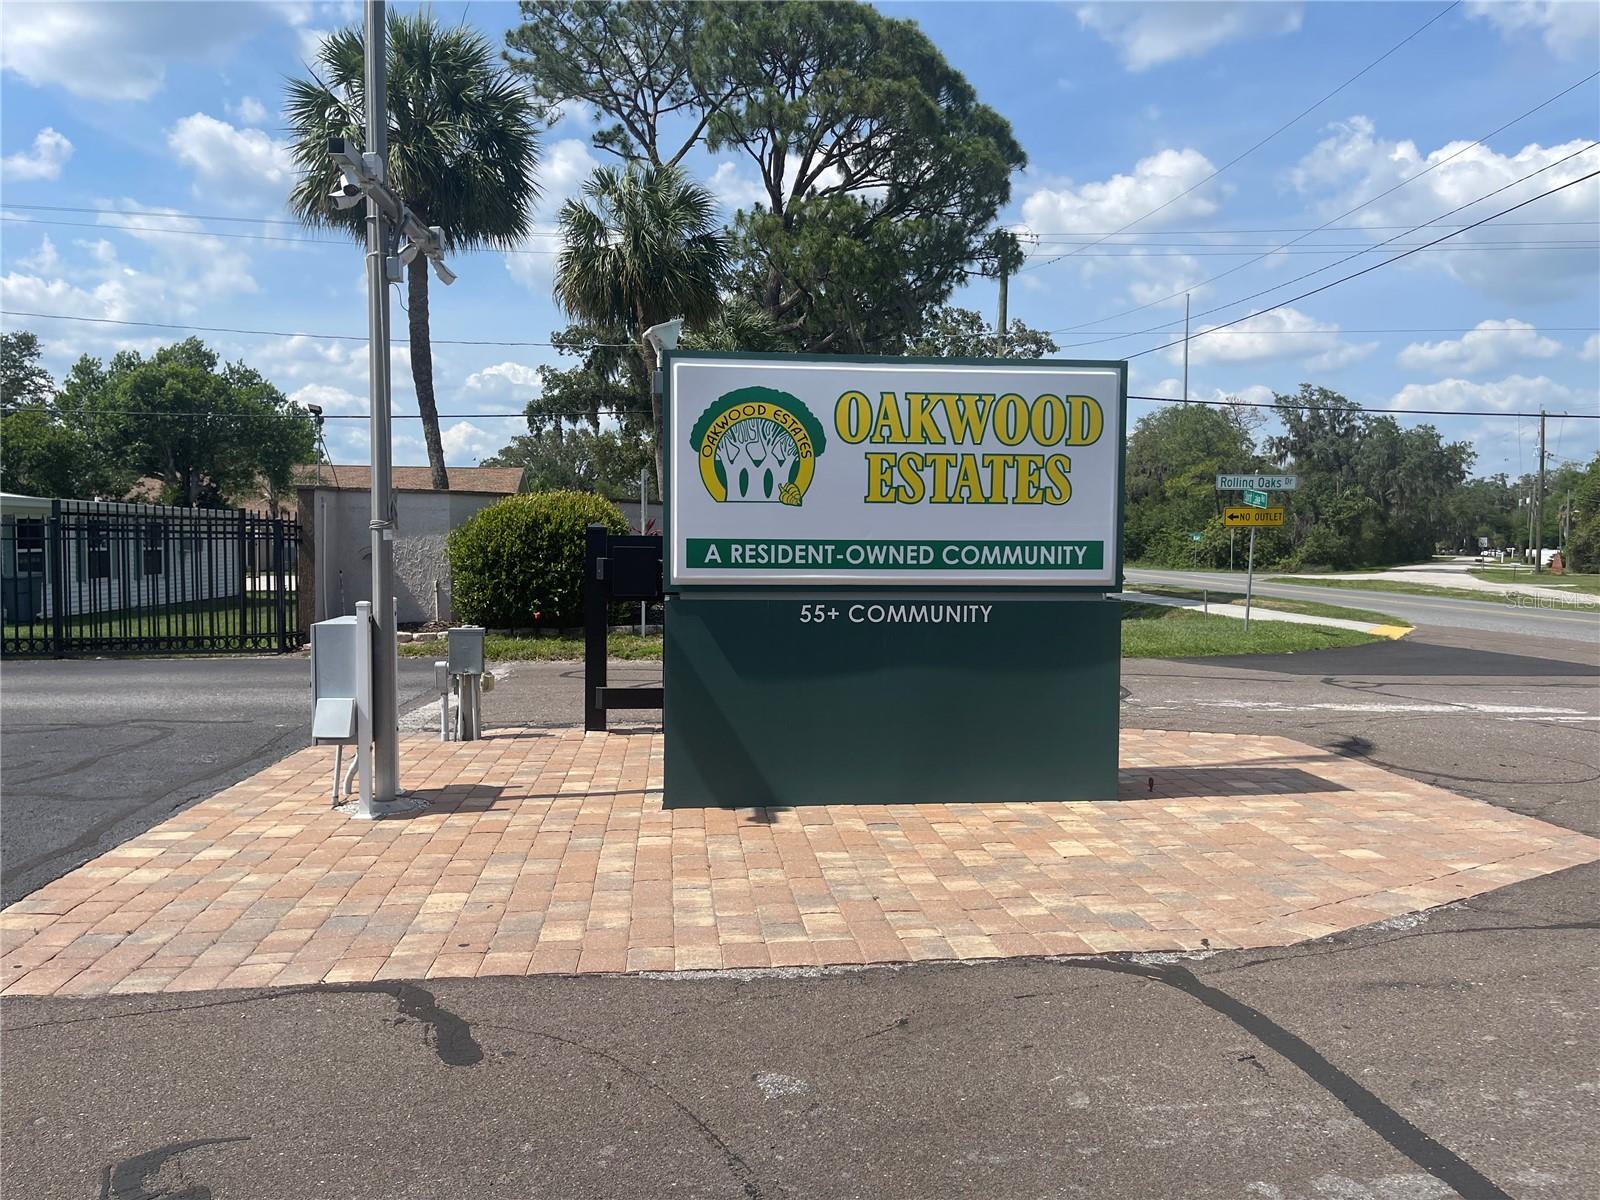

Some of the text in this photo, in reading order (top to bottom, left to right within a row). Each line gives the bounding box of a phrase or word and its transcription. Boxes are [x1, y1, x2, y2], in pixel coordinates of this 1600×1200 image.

[834, 390, 1104, 446] OAKWOOD
[702, 404, 812, 459] OAKWOOD ESTATES
[864, 452, 1072, 506] ESTATES
[1220, 476, 1293, 489] Rolling Oaks Dr
[1240, 513, 1282, 521] NO OUTLET
[704, 543, 1087, 566] A RESIDENT-OWNED COMMUNITY
[799, 604, 993, 624] 55+ COMMUNITY
